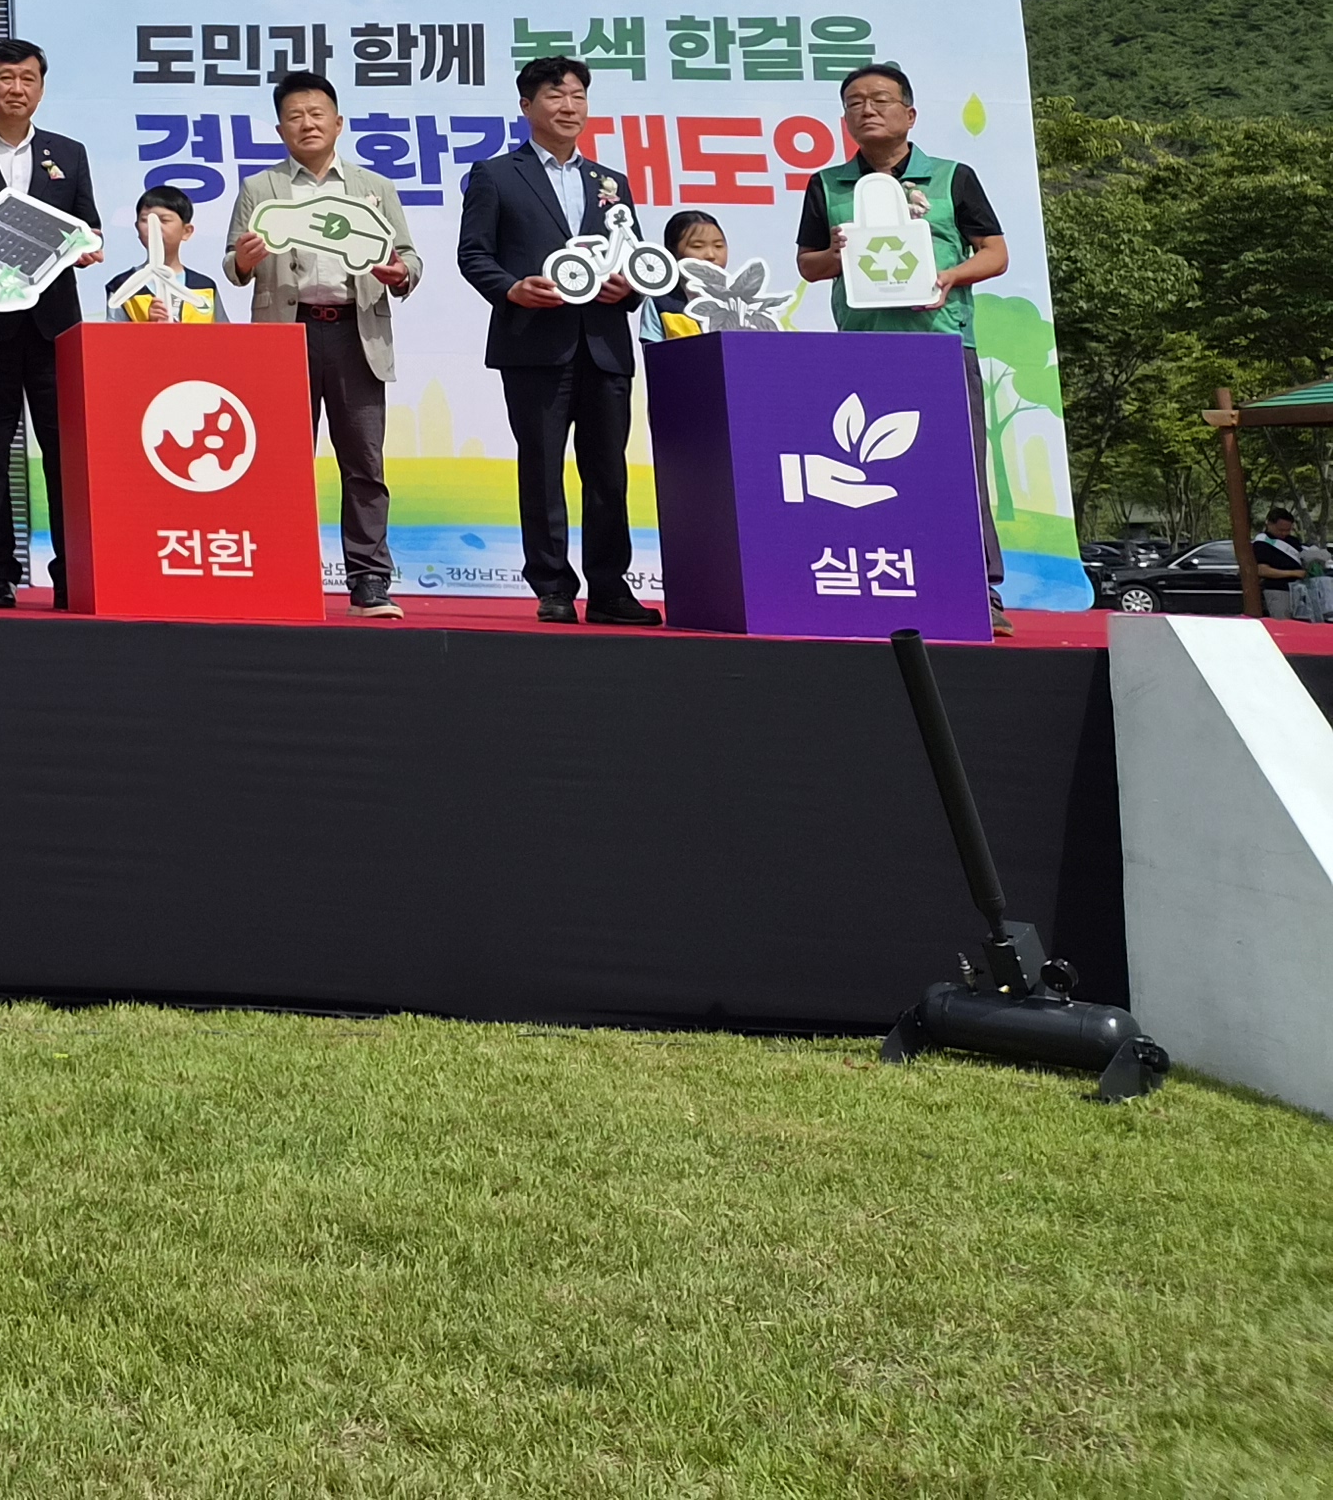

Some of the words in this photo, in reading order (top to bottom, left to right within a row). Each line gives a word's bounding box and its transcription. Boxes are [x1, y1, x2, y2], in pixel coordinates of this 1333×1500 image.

[133, 23, 333, 87] 도민과
[350, 22, 485, 86] 함께
[156, 529, 257, 578] 전환
[810, 546, 918, 598] 실천
